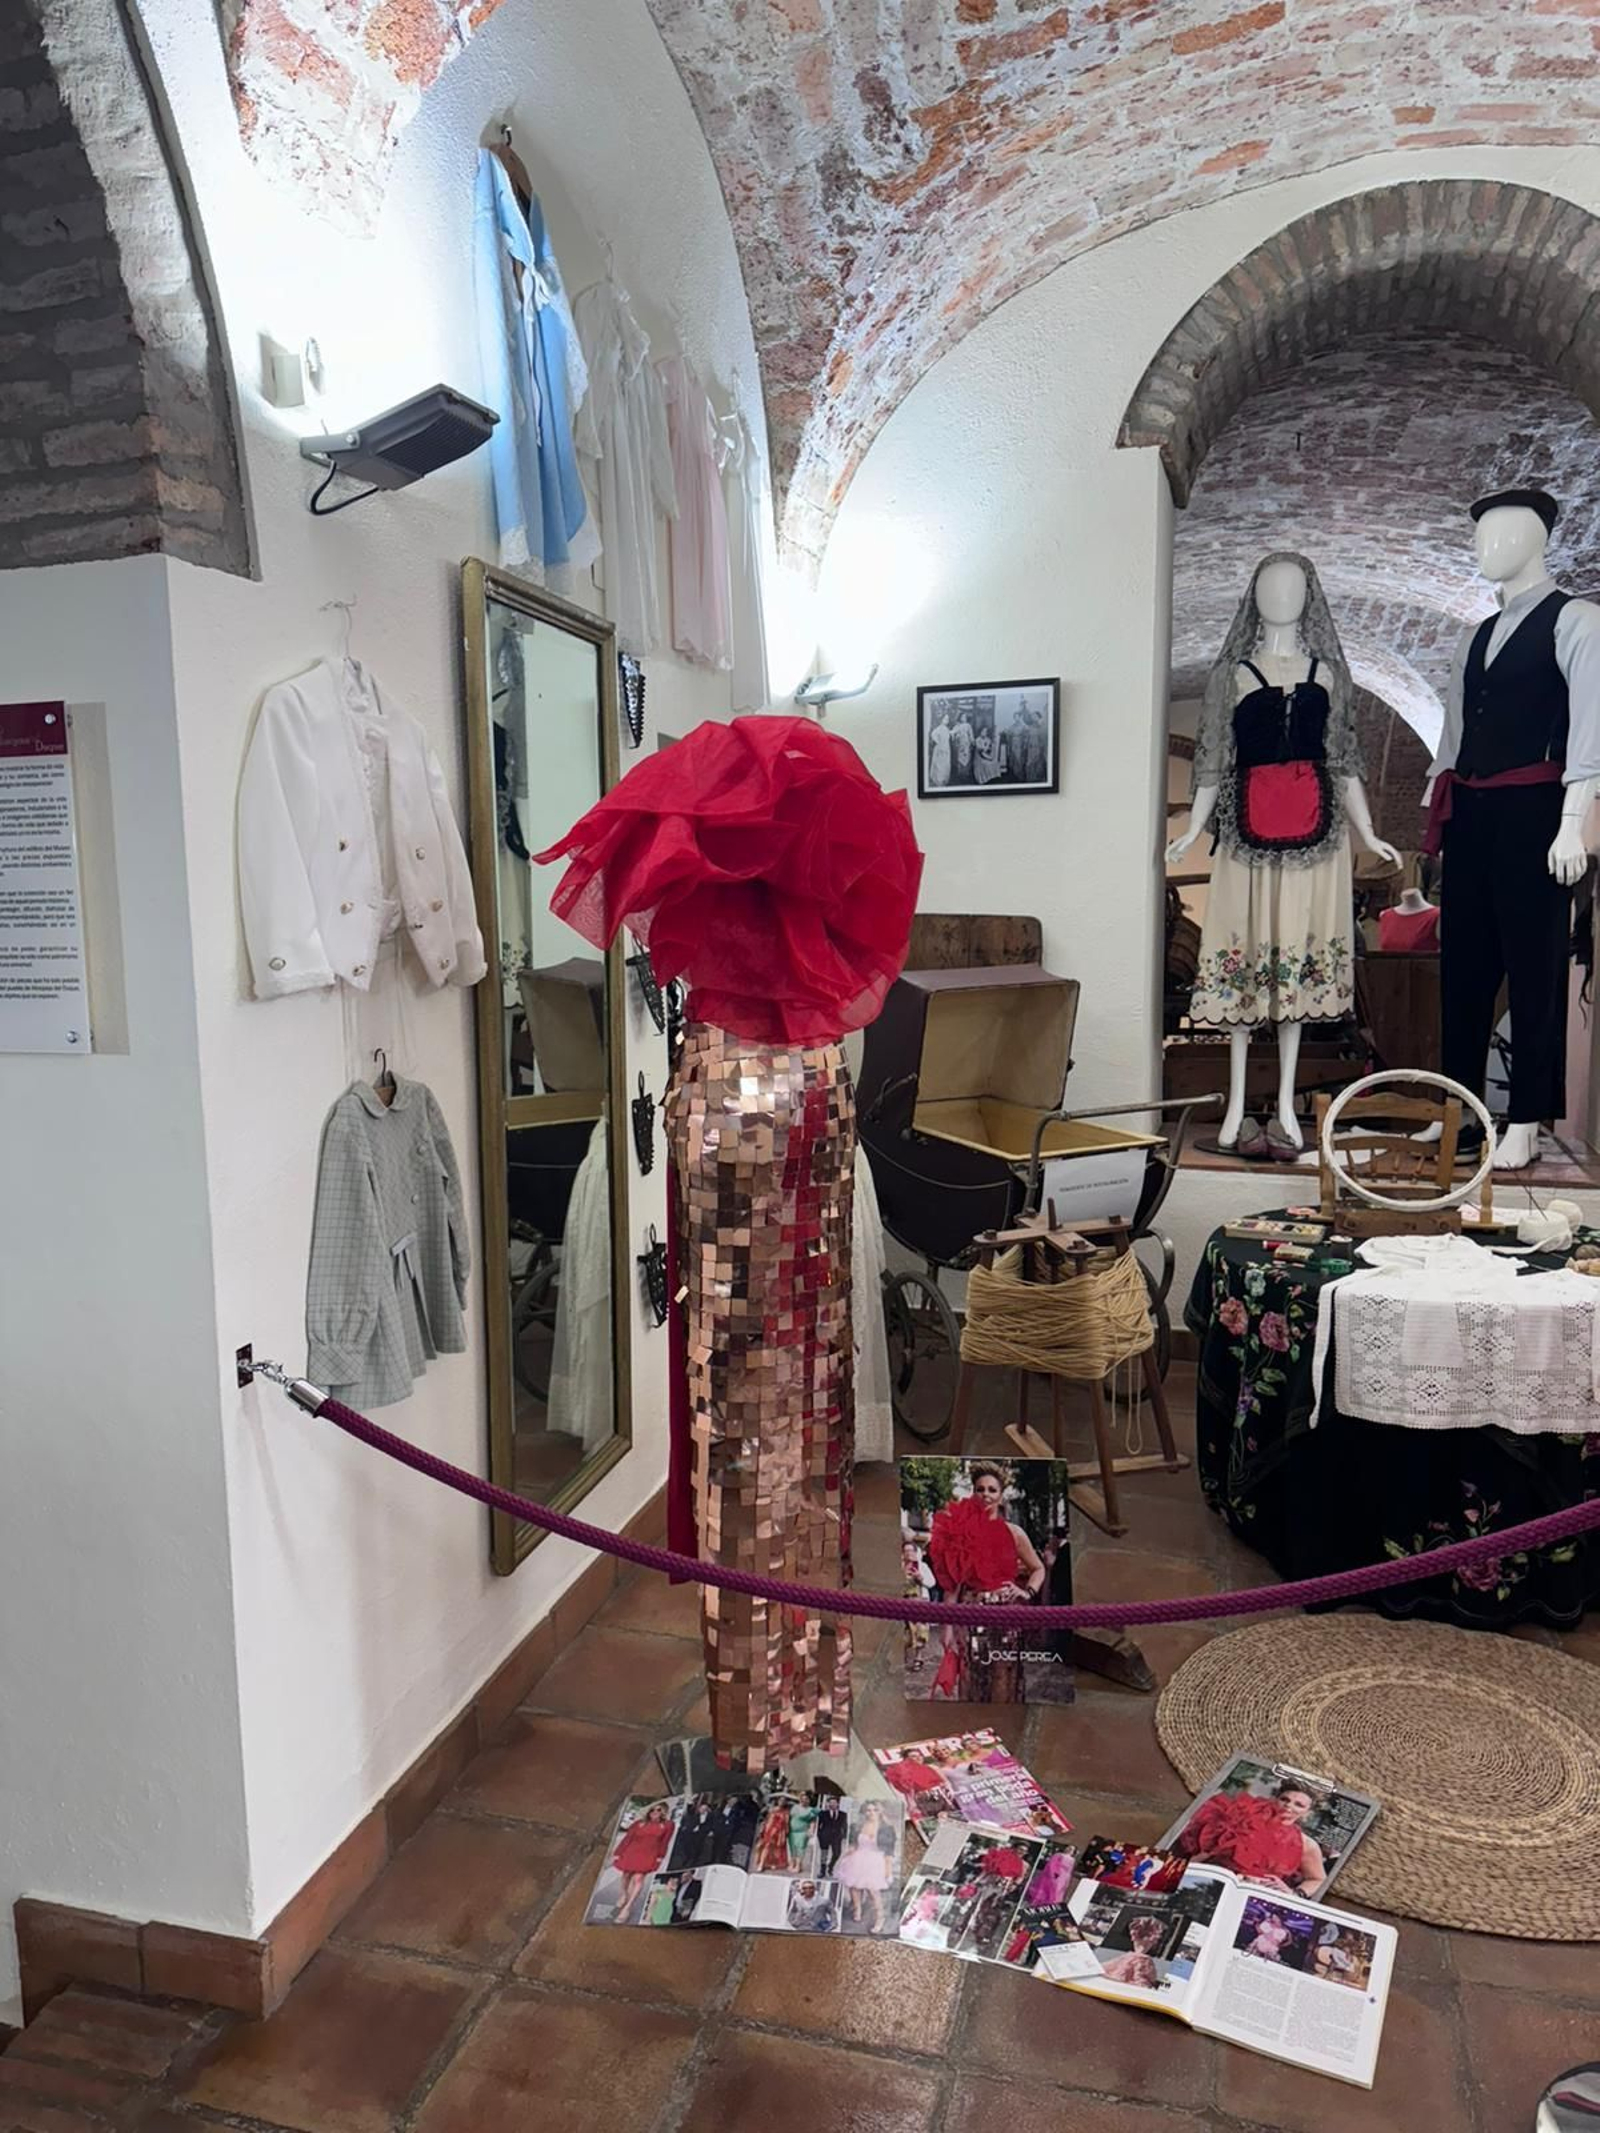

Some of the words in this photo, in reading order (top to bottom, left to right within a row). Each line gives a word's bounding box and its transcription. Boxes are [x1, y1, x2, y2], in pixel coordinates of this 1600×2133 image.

[959, 1788, 995, 1804] gran
[994, 1780, 1034, 1794] boda
[970, 1772, 1027, 1792] primera
[985, 1792, 1010, 1804] del
[1012, 1788, 1039, 1800] año
